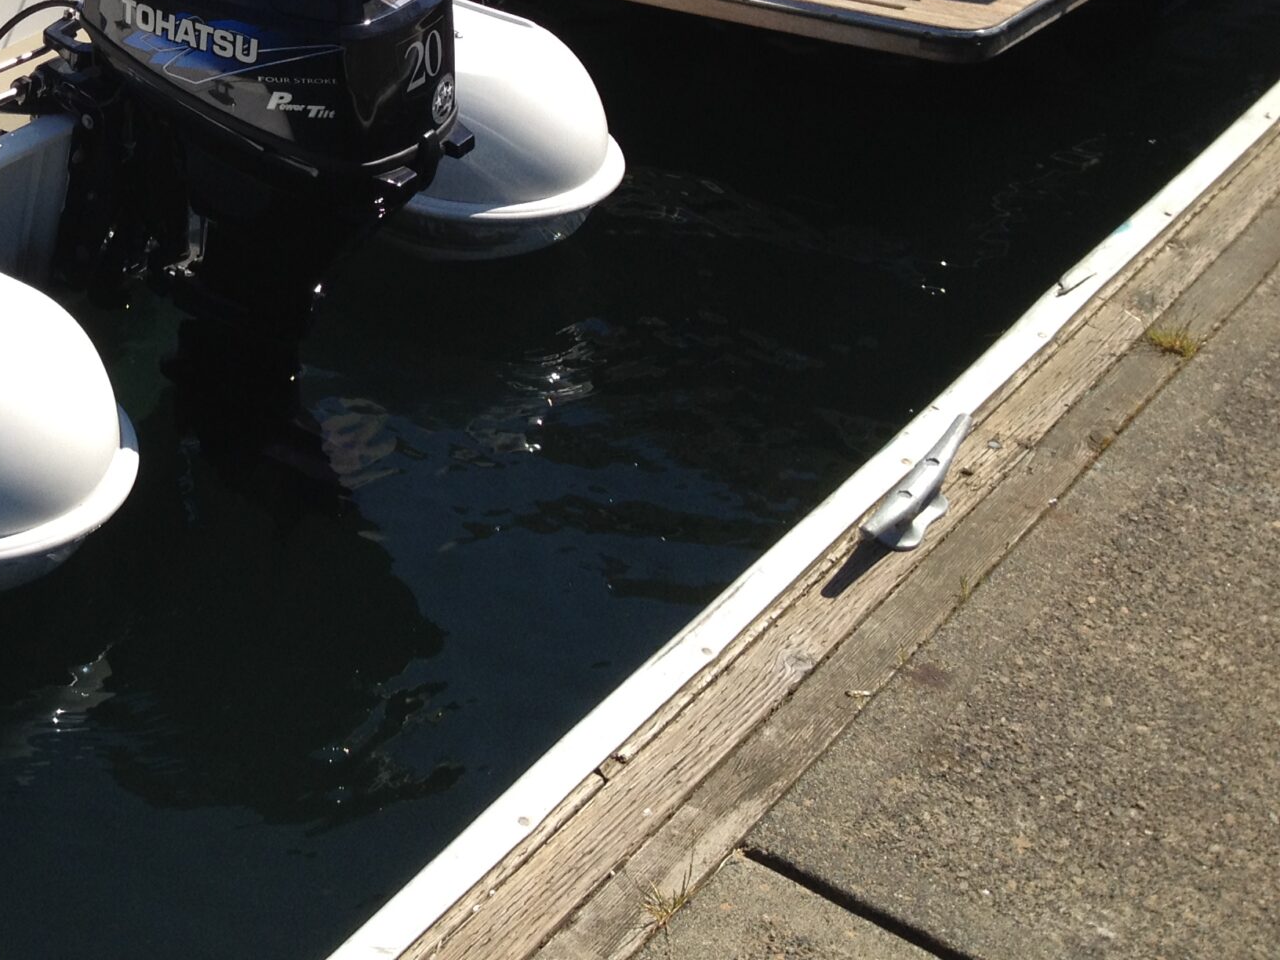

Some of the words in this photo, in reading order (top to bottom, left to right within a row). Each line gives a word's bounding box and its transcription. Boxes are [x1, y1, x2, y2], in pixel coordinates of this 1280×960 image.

[405, 29, 442, 92] 20
[257, 75, 290, 84] FOUR
[294, 76, 337, 86] STROKE
[306, 105, 336, 119] Tilt
